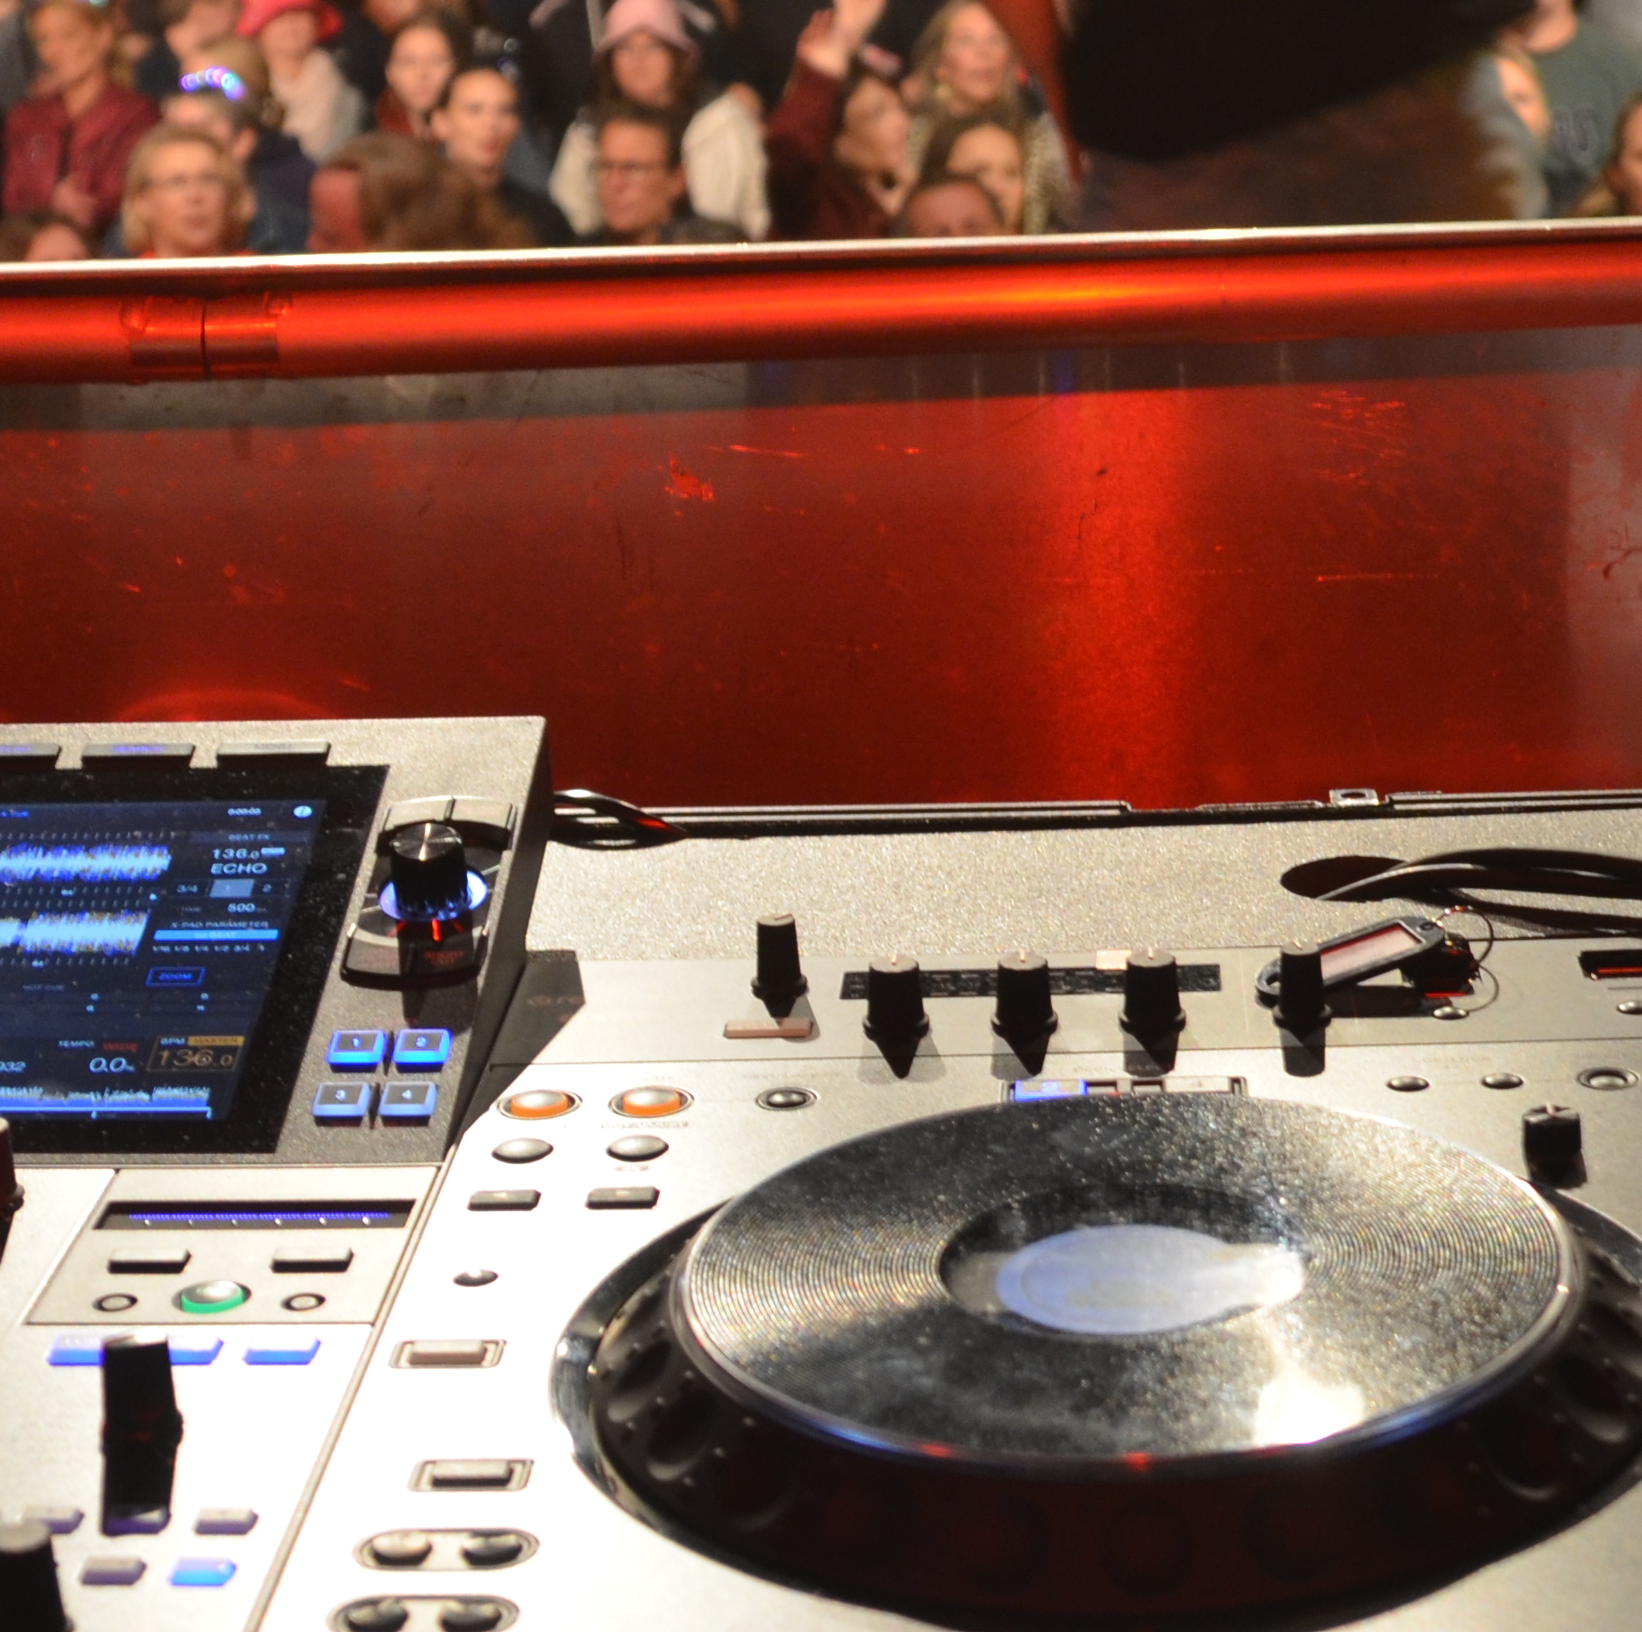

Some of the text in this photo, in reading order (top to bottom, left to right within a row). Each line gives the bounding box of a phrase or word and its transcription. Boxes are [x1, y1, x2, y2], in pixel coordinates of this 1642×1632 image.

[210, 862, 268, 874] ECHO
[227, 903, 256, 914] 500
[415, 1035, 428, 1048] 2
[157, 1049, 234, 1068] 136.0
[335, 1089, 412, 1100] 3 4
